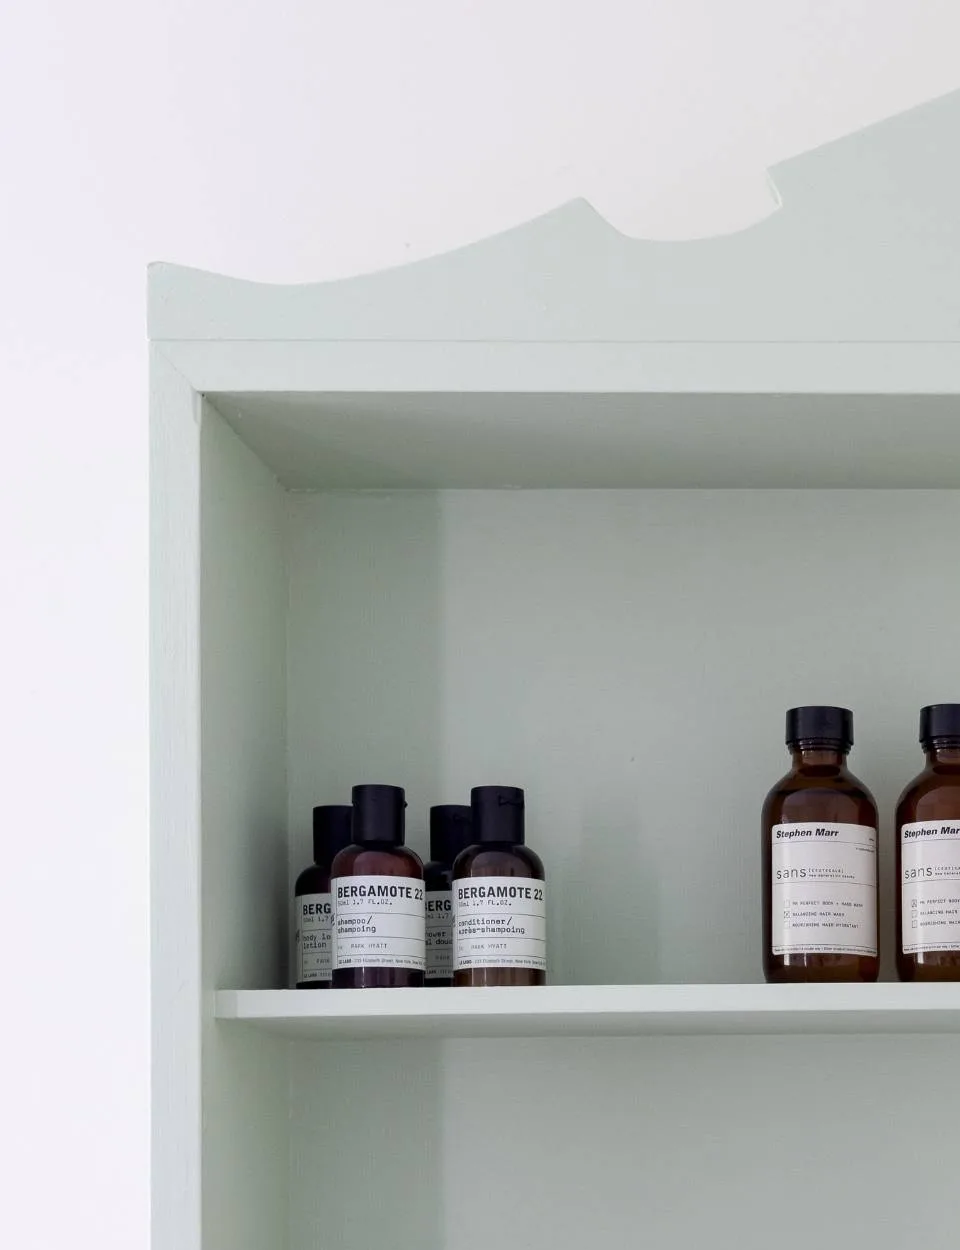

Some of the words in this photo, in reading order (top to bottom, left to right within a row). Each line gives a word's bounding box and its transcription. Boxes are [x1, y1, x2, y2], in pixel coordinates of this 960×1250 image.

[776, 828, 812, 839] Stephen
[815, 828, 839, 837] Marr
[904, 827, 938, 839] Stephen
[776, 868, 807, 880] sans
[904, 867, 933, 880] sans
[337, 885, 413, 899] BERGAMOTE
[414, 887, 424, 901] 22
[458, 886, 532, 900] BERGAMOTE
[533, 888, 543, 901] 22
[303, 902, 332, 915] BERG
[425, 899, 452, 912] ERG
[458, 916, 513, 927] conditioner/
[321, 932, 332, 941] lo
